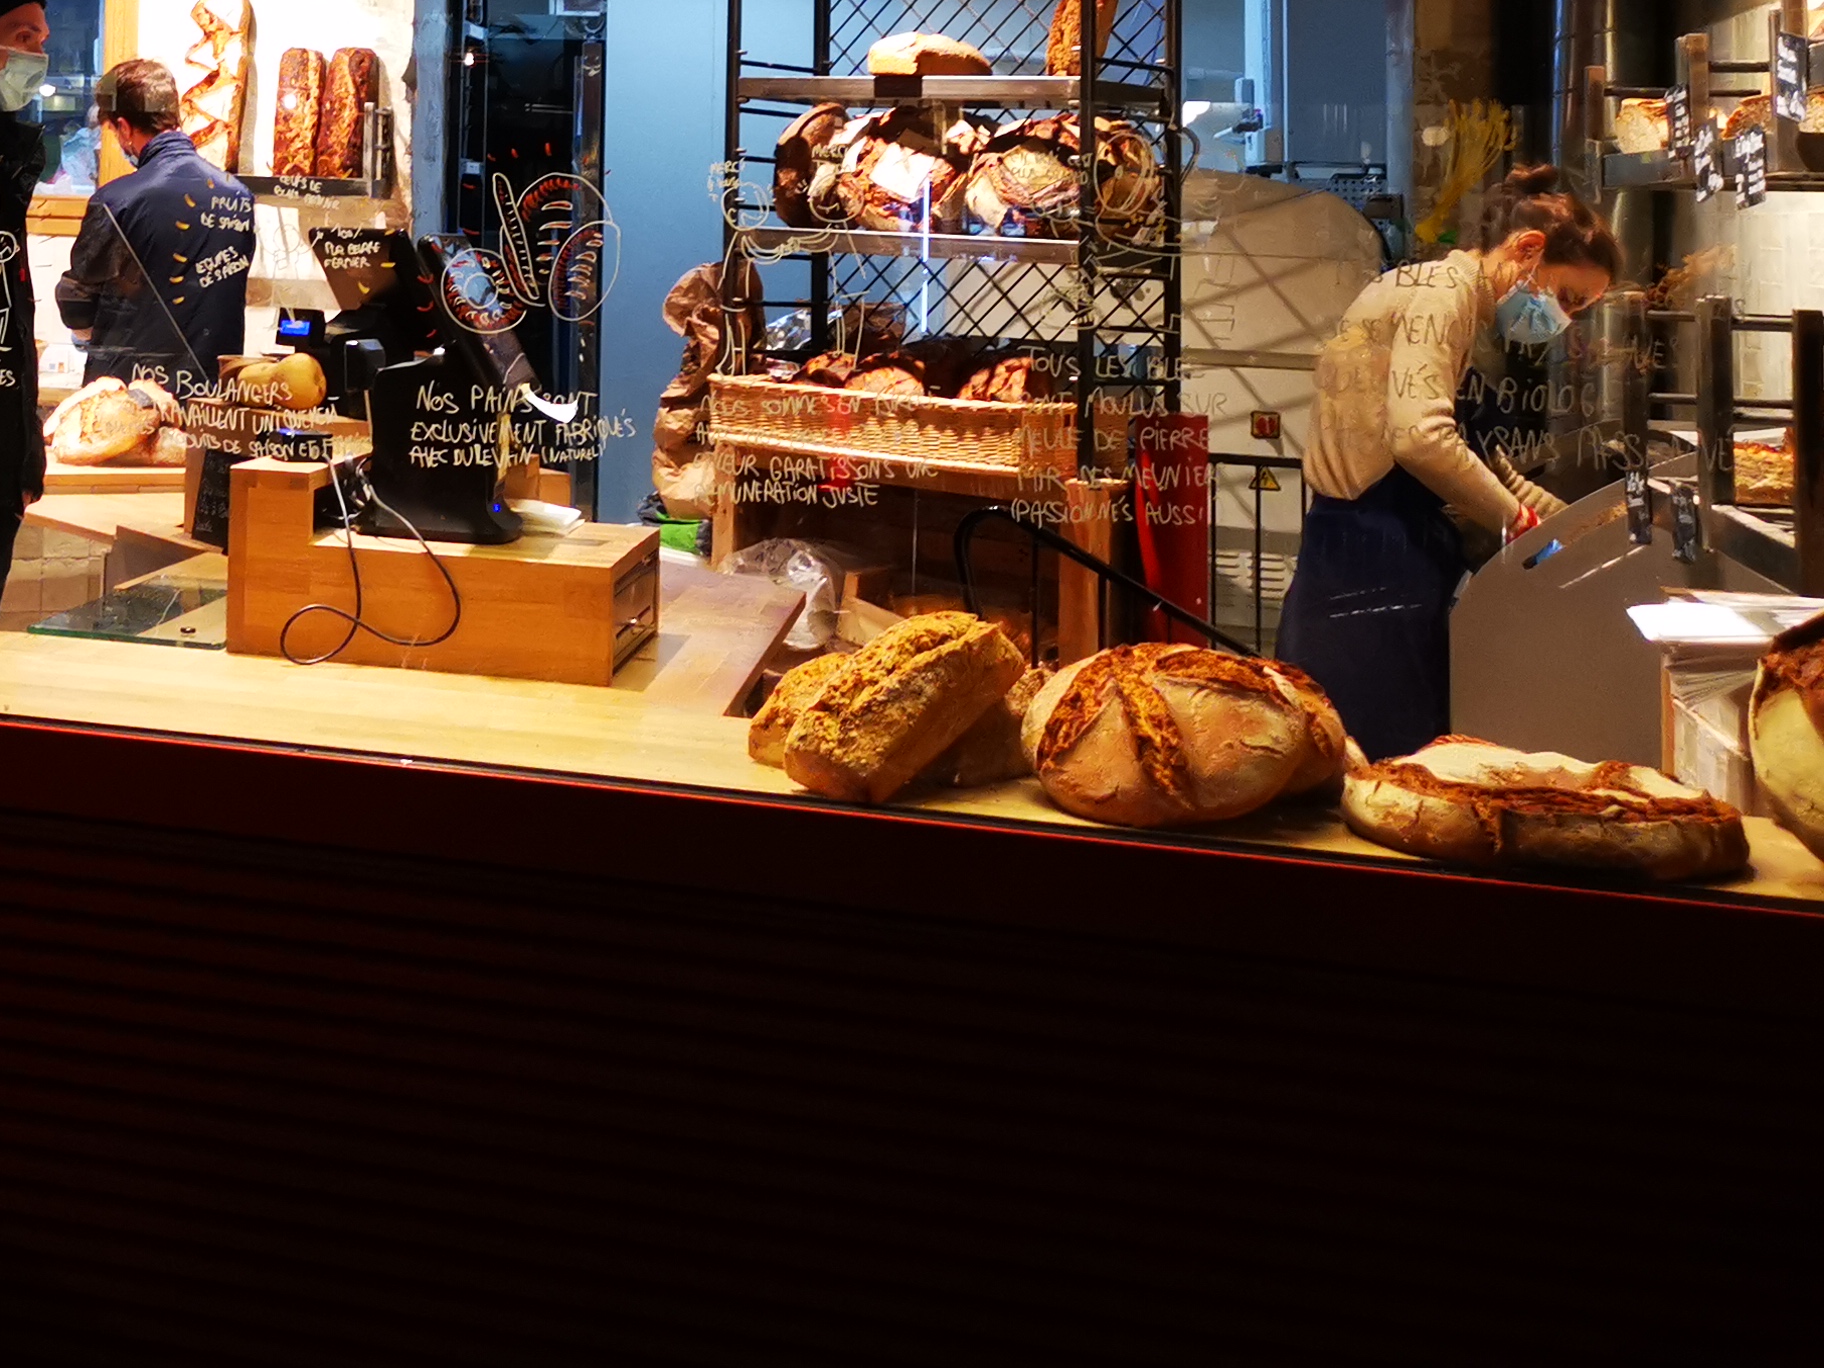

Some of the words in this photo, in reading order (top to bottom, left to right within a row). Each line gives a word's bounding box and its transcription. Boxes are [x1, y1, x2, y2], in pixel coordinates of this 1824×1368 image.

[1017, 345, 1082, 379] TOUS
[131, 362, 170, 386] NOS
[175, 369, 293, 406] BOULANGERS
[416, 380, 460, 415] NOS
[410, 420, 547, 445] EXCLUSIVEMENT
[1139, 421, 1210, 452] PIERRE
[248, 436, 295, 460] SAISON
[409, 446, 449, 466] AVEC
[817, 482, 881, 509] JUSTE
